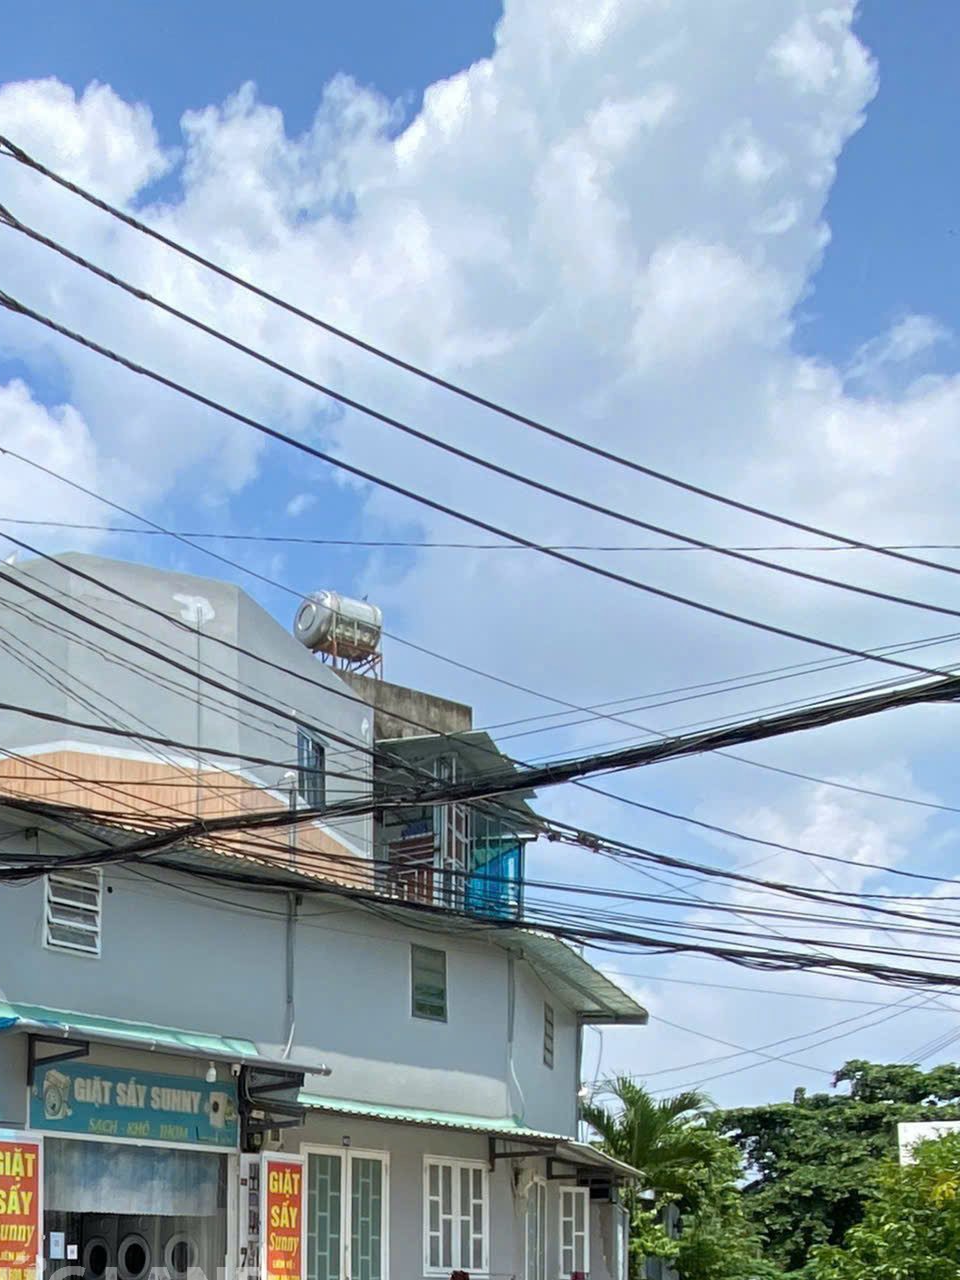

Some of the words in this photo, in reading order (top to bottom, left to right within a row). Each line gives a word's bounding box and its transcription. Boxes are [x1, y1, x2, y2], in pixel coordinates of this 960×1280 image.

[74, 1076, 113, 1108] GIẶT
[150, 1085, 202, 1115] SUNNY
[269, 1168, 301, 1199] GIẶT
[271, 1200, 298, 1229] SẤY
[269, 1232, 300, 1257] Sunny
